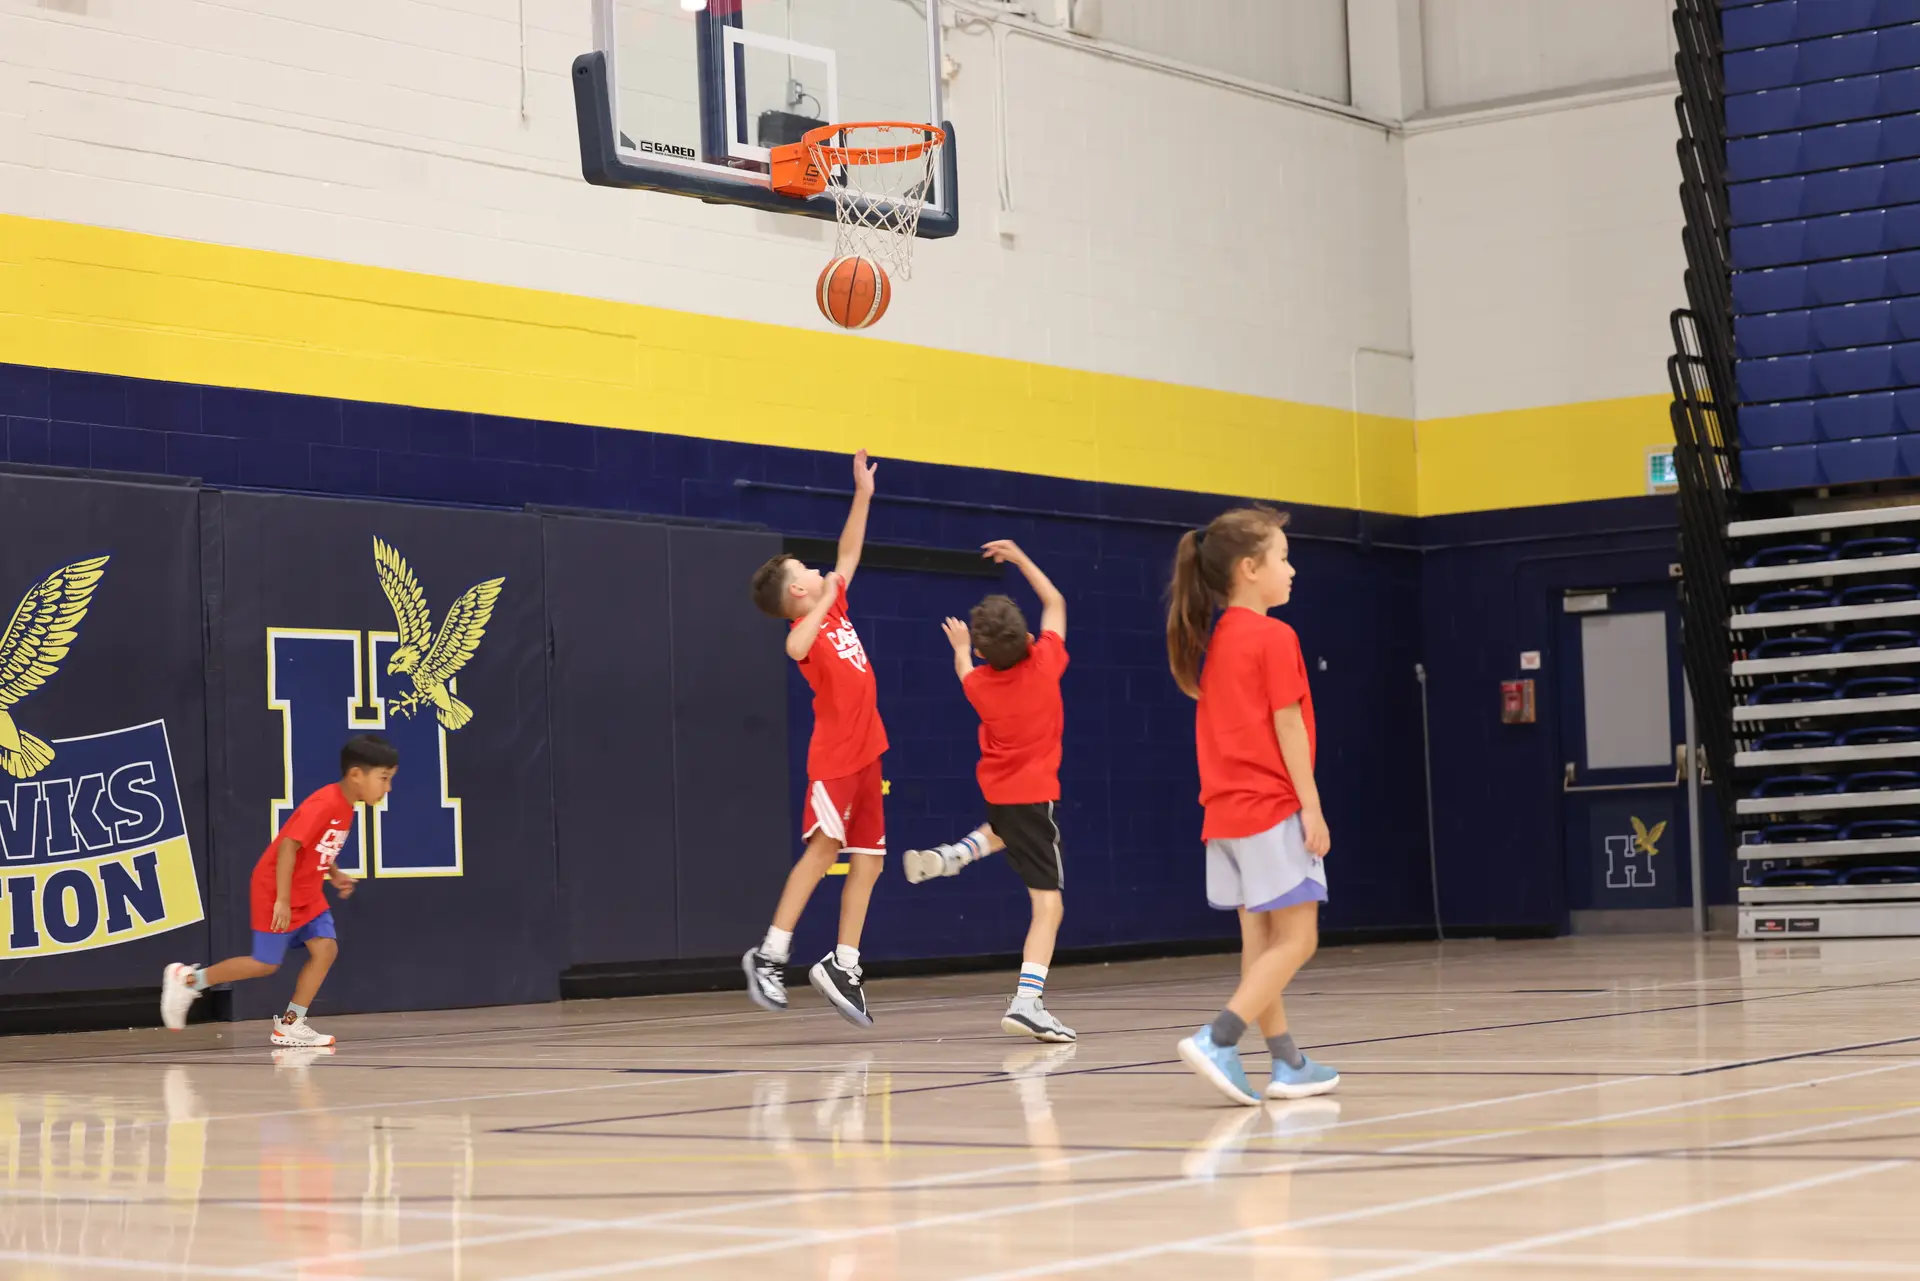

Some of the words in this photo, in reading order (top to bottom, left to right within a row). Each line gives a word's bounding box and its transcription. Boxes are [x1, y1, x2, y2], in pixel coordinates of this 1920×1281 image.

[654, 142, 696, 158] GARED
[266, 627, 464, 879] H
[1604, 834, 1656, 888] H
[0, 850, 168, 950] ION
